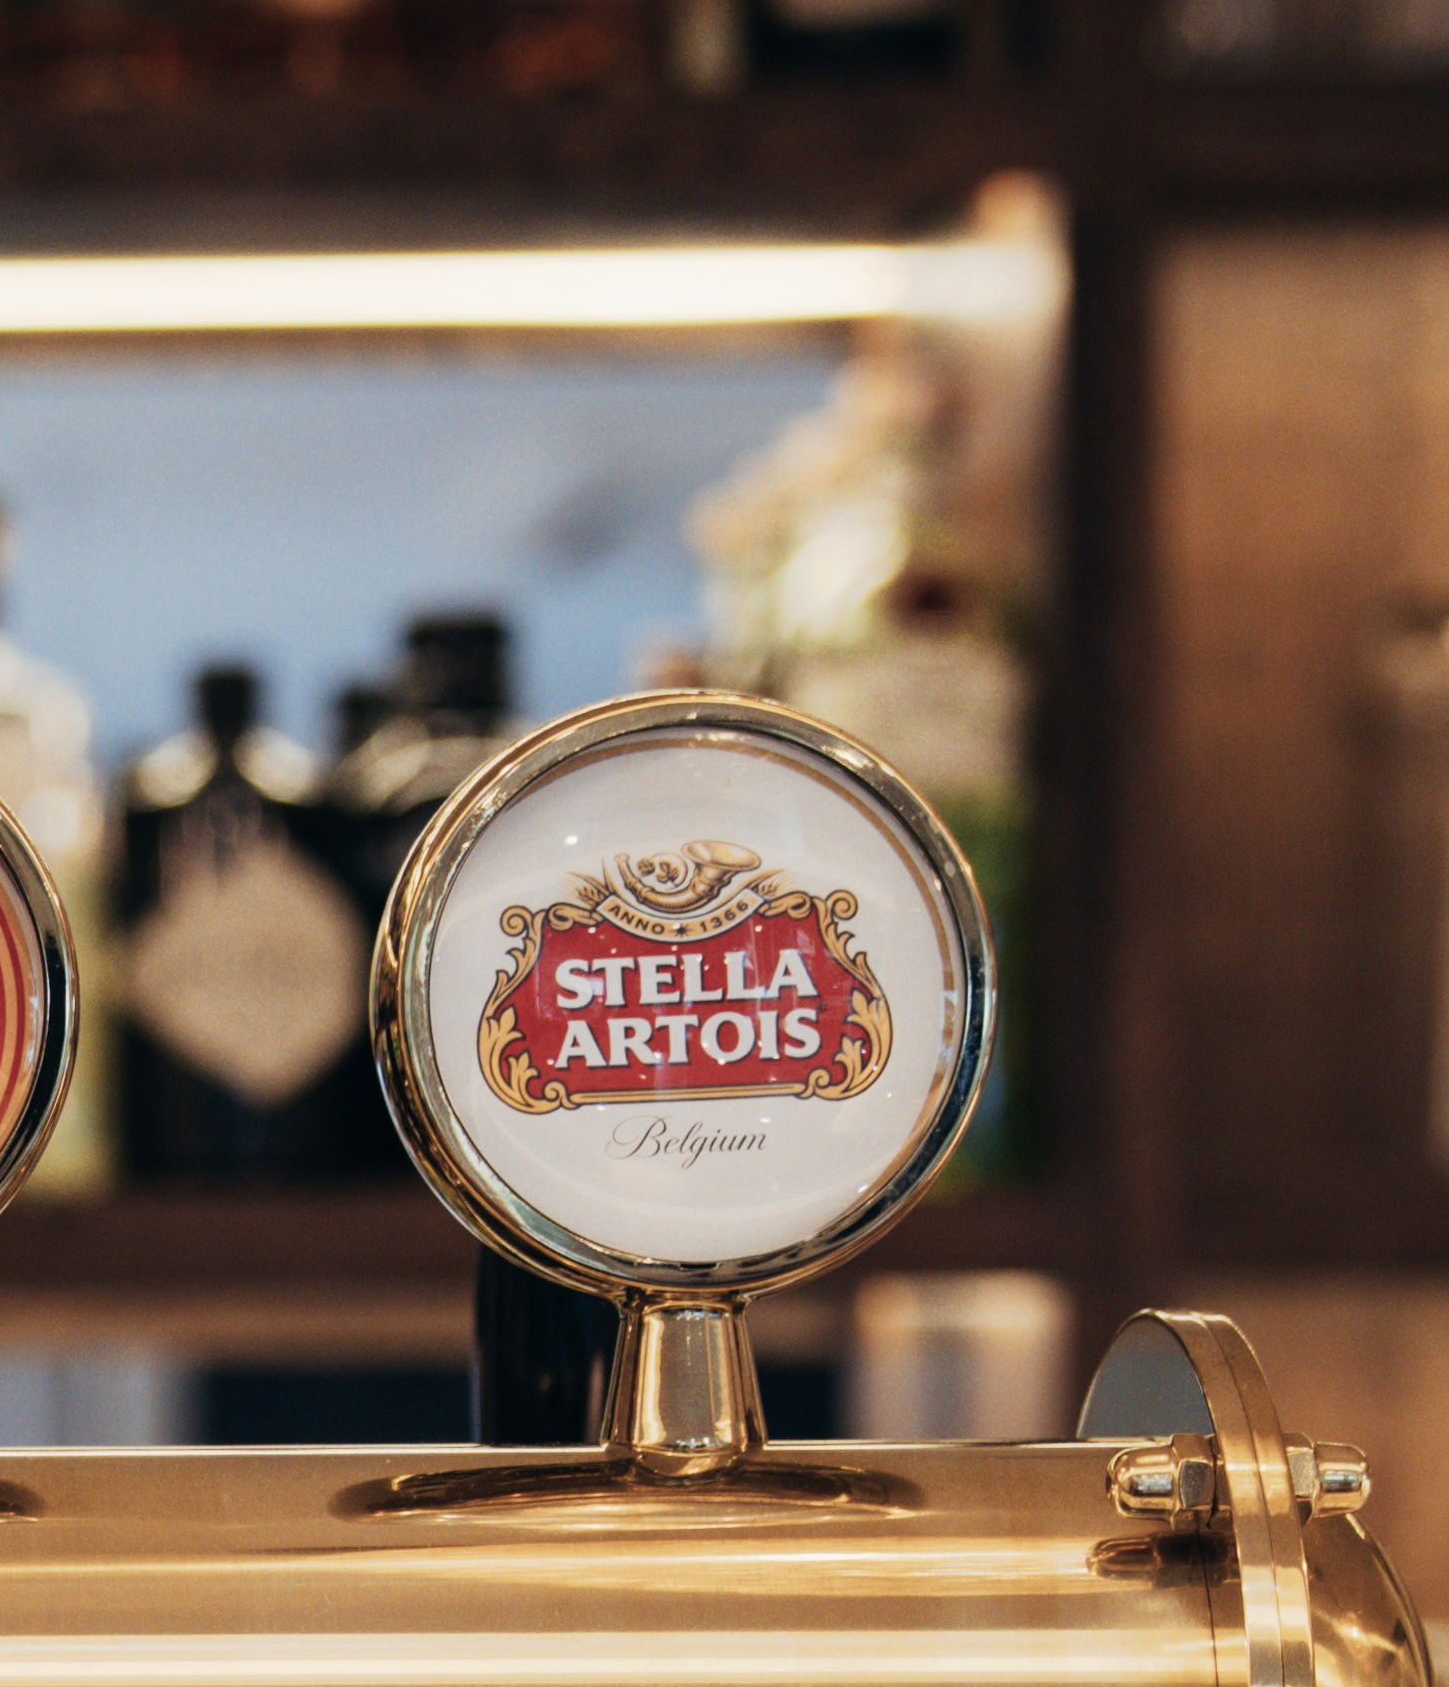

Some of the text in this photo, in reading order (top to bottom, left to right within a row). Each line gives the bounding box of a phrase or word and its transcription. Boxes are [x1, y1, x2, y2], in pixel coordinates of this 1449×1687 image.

[608, 899, 750, 936] ANNO 1366
[554, 948, 820, 1010] STELLA
[554, 1008, 822, 1069] ARTOIS
[605, 1114, 768, 1170] Belgium
